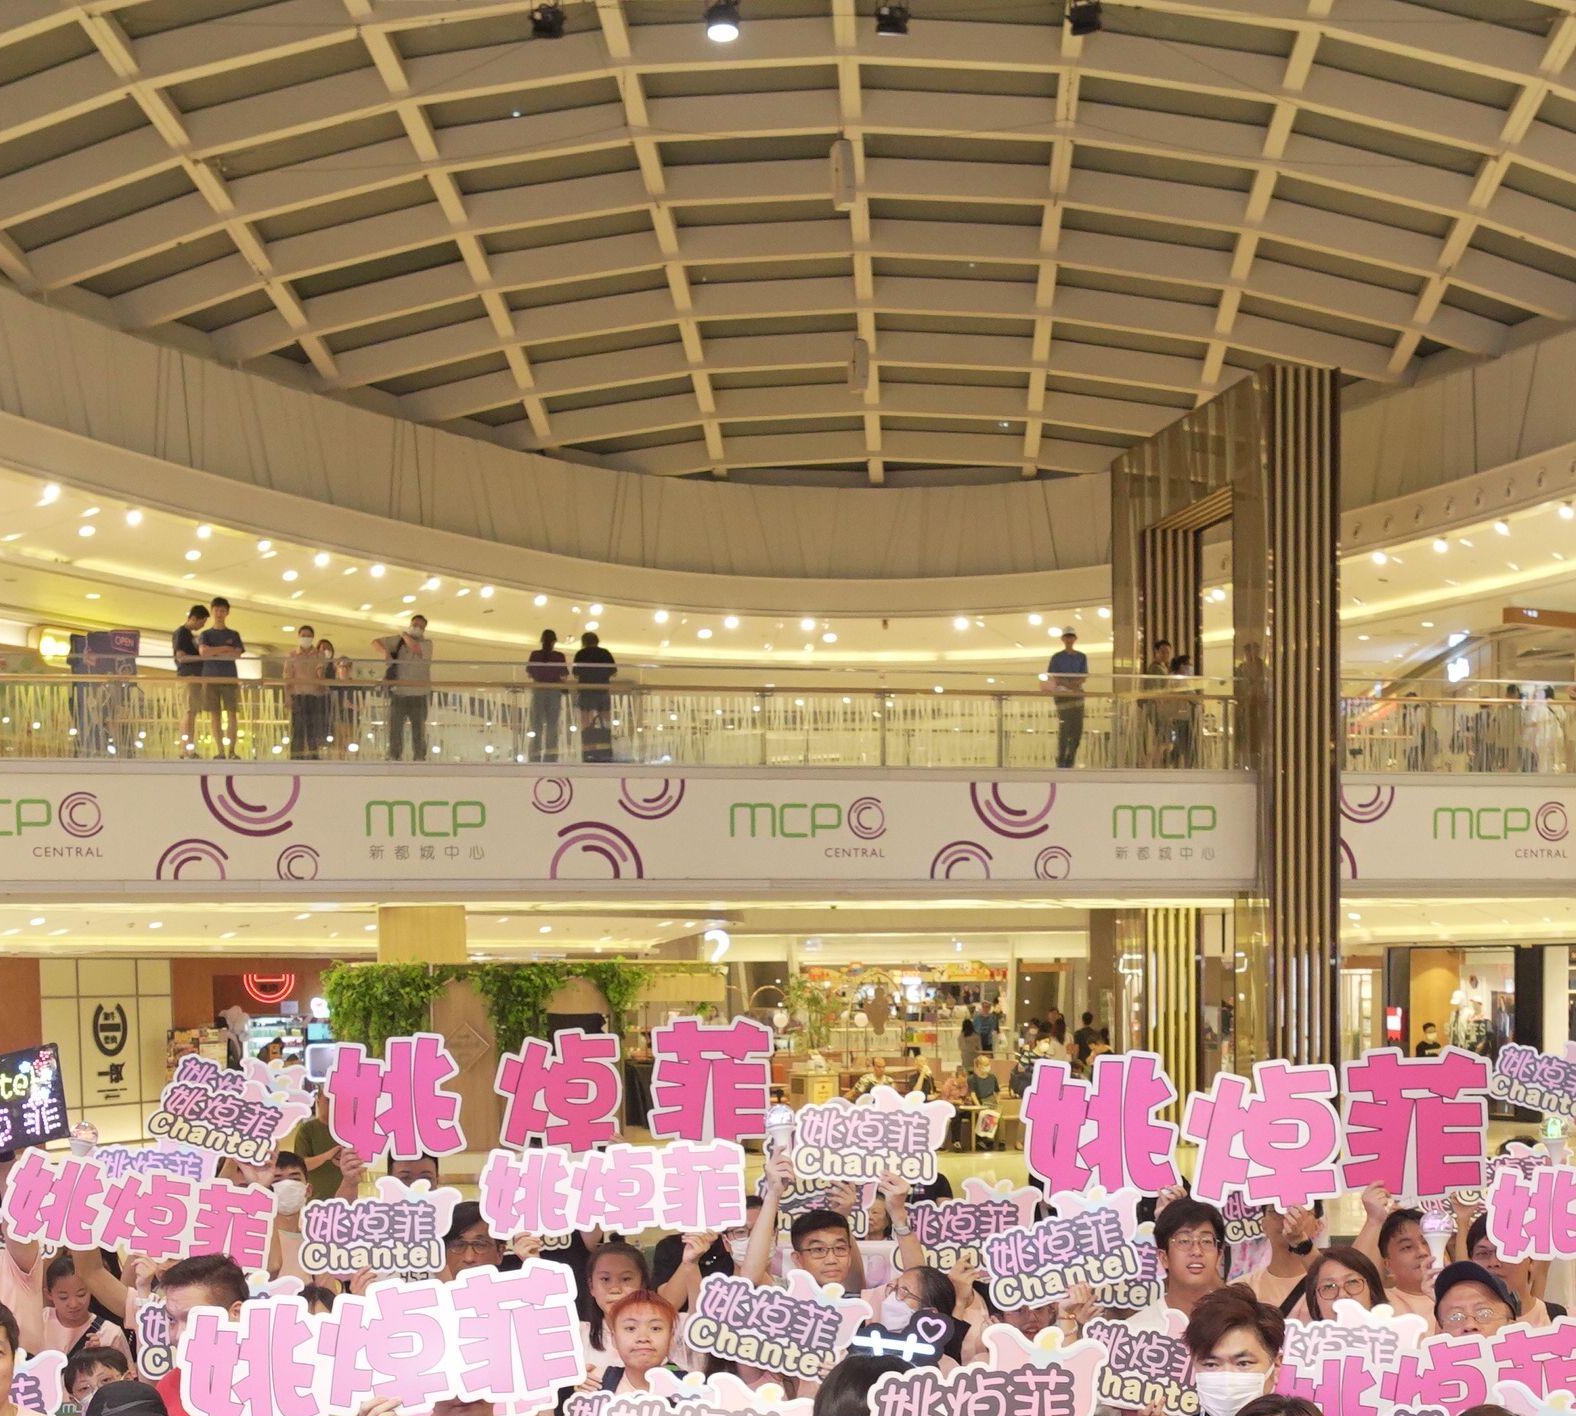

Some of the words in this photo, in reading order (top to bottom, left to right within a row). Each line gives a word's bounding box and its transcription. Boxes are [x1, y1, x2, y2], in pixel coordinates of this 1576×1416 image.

[32, 846, 103, 858] CENTRAL
[368, 843, 486, 861] 新都城中心
[824, 846, 885, 859] CENTRAL
[1114, 845, 1217, 861] 新都城中心
[1514, 848, 1568, 859] CENTRAL
[166, 1085, 283, 1138] 姚焯菲
[803, 1110, 929, 1152] 姚焯菲
[149, 1112, 271, 1160] Chantel
[795, 1147, 932, 1181] Chantel
[486, 1146, 742, 1231] 姚焯菲
[8, 1154, 273, 1268] 姚焯菲
[307, 1201, 436, 1242] 姚焯菲
[305, 1240, 441, 1268] Chantel
[991, 1209, 1123, 1272] 姚焯菲
[995, 1250, 1133, 1304] Chantel
[704, 1281, 841, 1348] 姚焯菲
